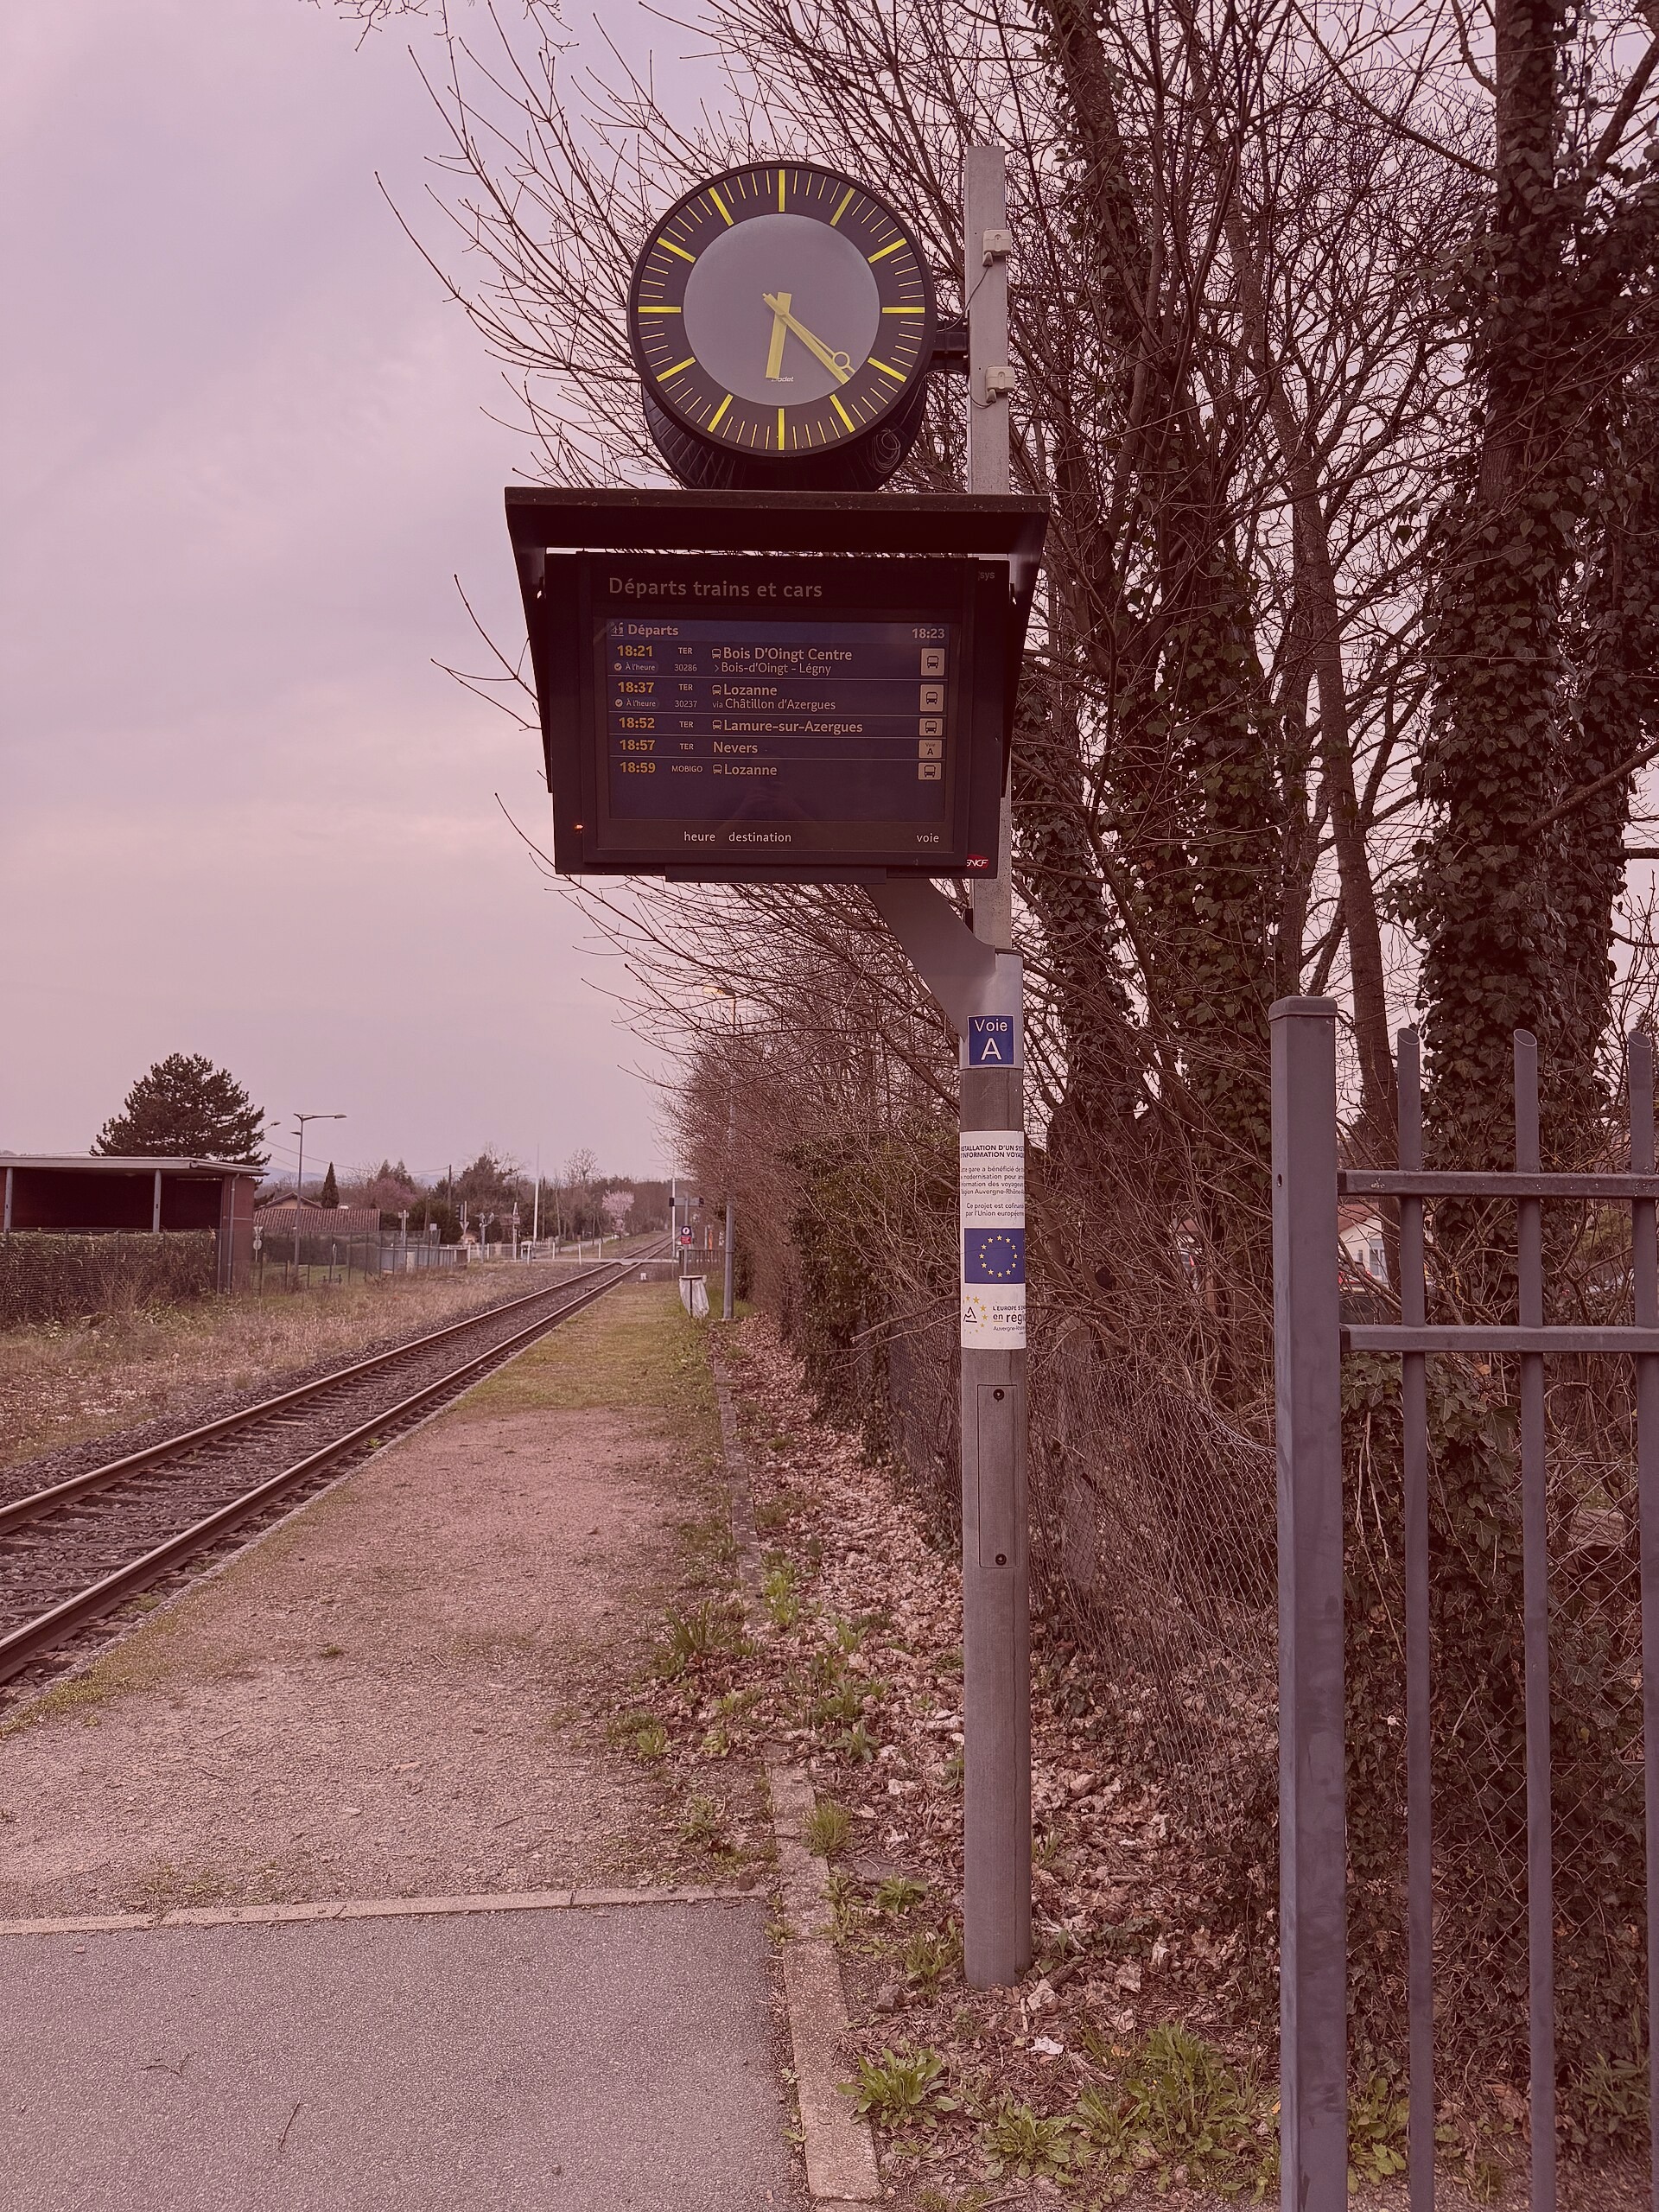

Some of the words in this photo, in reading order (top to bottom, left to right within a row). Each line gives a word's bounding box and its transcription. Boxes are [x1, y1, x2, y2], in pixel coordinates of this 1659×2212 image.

[978, 570, 995, 582] sys
[609, 577, 687, 598] Départs
[693, 580, 750, 597] trains
[757, 582, 777, 598] et
[783, 583, 823, 598] cars
[627, 624, 679, 638] Départs
[912, 628, 945, 639] 18:23
[617, 645, 653, 658] 18:21
[723, 647, 751, 659] Bois
[754, 647, 804, 663] D'Oingt
[808, 648, 853, 660] Centre
[625, 662, 632, 671] À
[632, 663, 656, 671] l'heure
[674, 664, 697, 672] 30286
[721, 662, 788, 676] Bois-d'Oingt
[799, 663, 831, 677] Légny
[618, 681, 654, 693] 18:37
[724, 683, 778, 696] Lozanne
[626, 698, 632, 707] À
[632, 699, 657, 708] l'heure
[725, 698, 774, 709] Châtillon
[778, 699, 836, 713] d'Azergues
[619, 716, 655, 728] 18:52
[724, 719, 863, 735] Lamure-sur-Azergues
[620, 739, 656, 751] 18:57
[713, 741, 759, 753] Nevers
[620, 761, 656, 773] 18:59
[671, 765, 703, 773] MOBIGO
[724, 764, 778, 775] Lozanne
[683, 831, 715, 842] heure
[728, 831, 791, 842] destination
[916, 832, 939, 843] voie
[966, 859, 988, 868] SNCF
[974, 1018, 1008, 1032] Voie
[981, 1037, 1002, 1060] A
